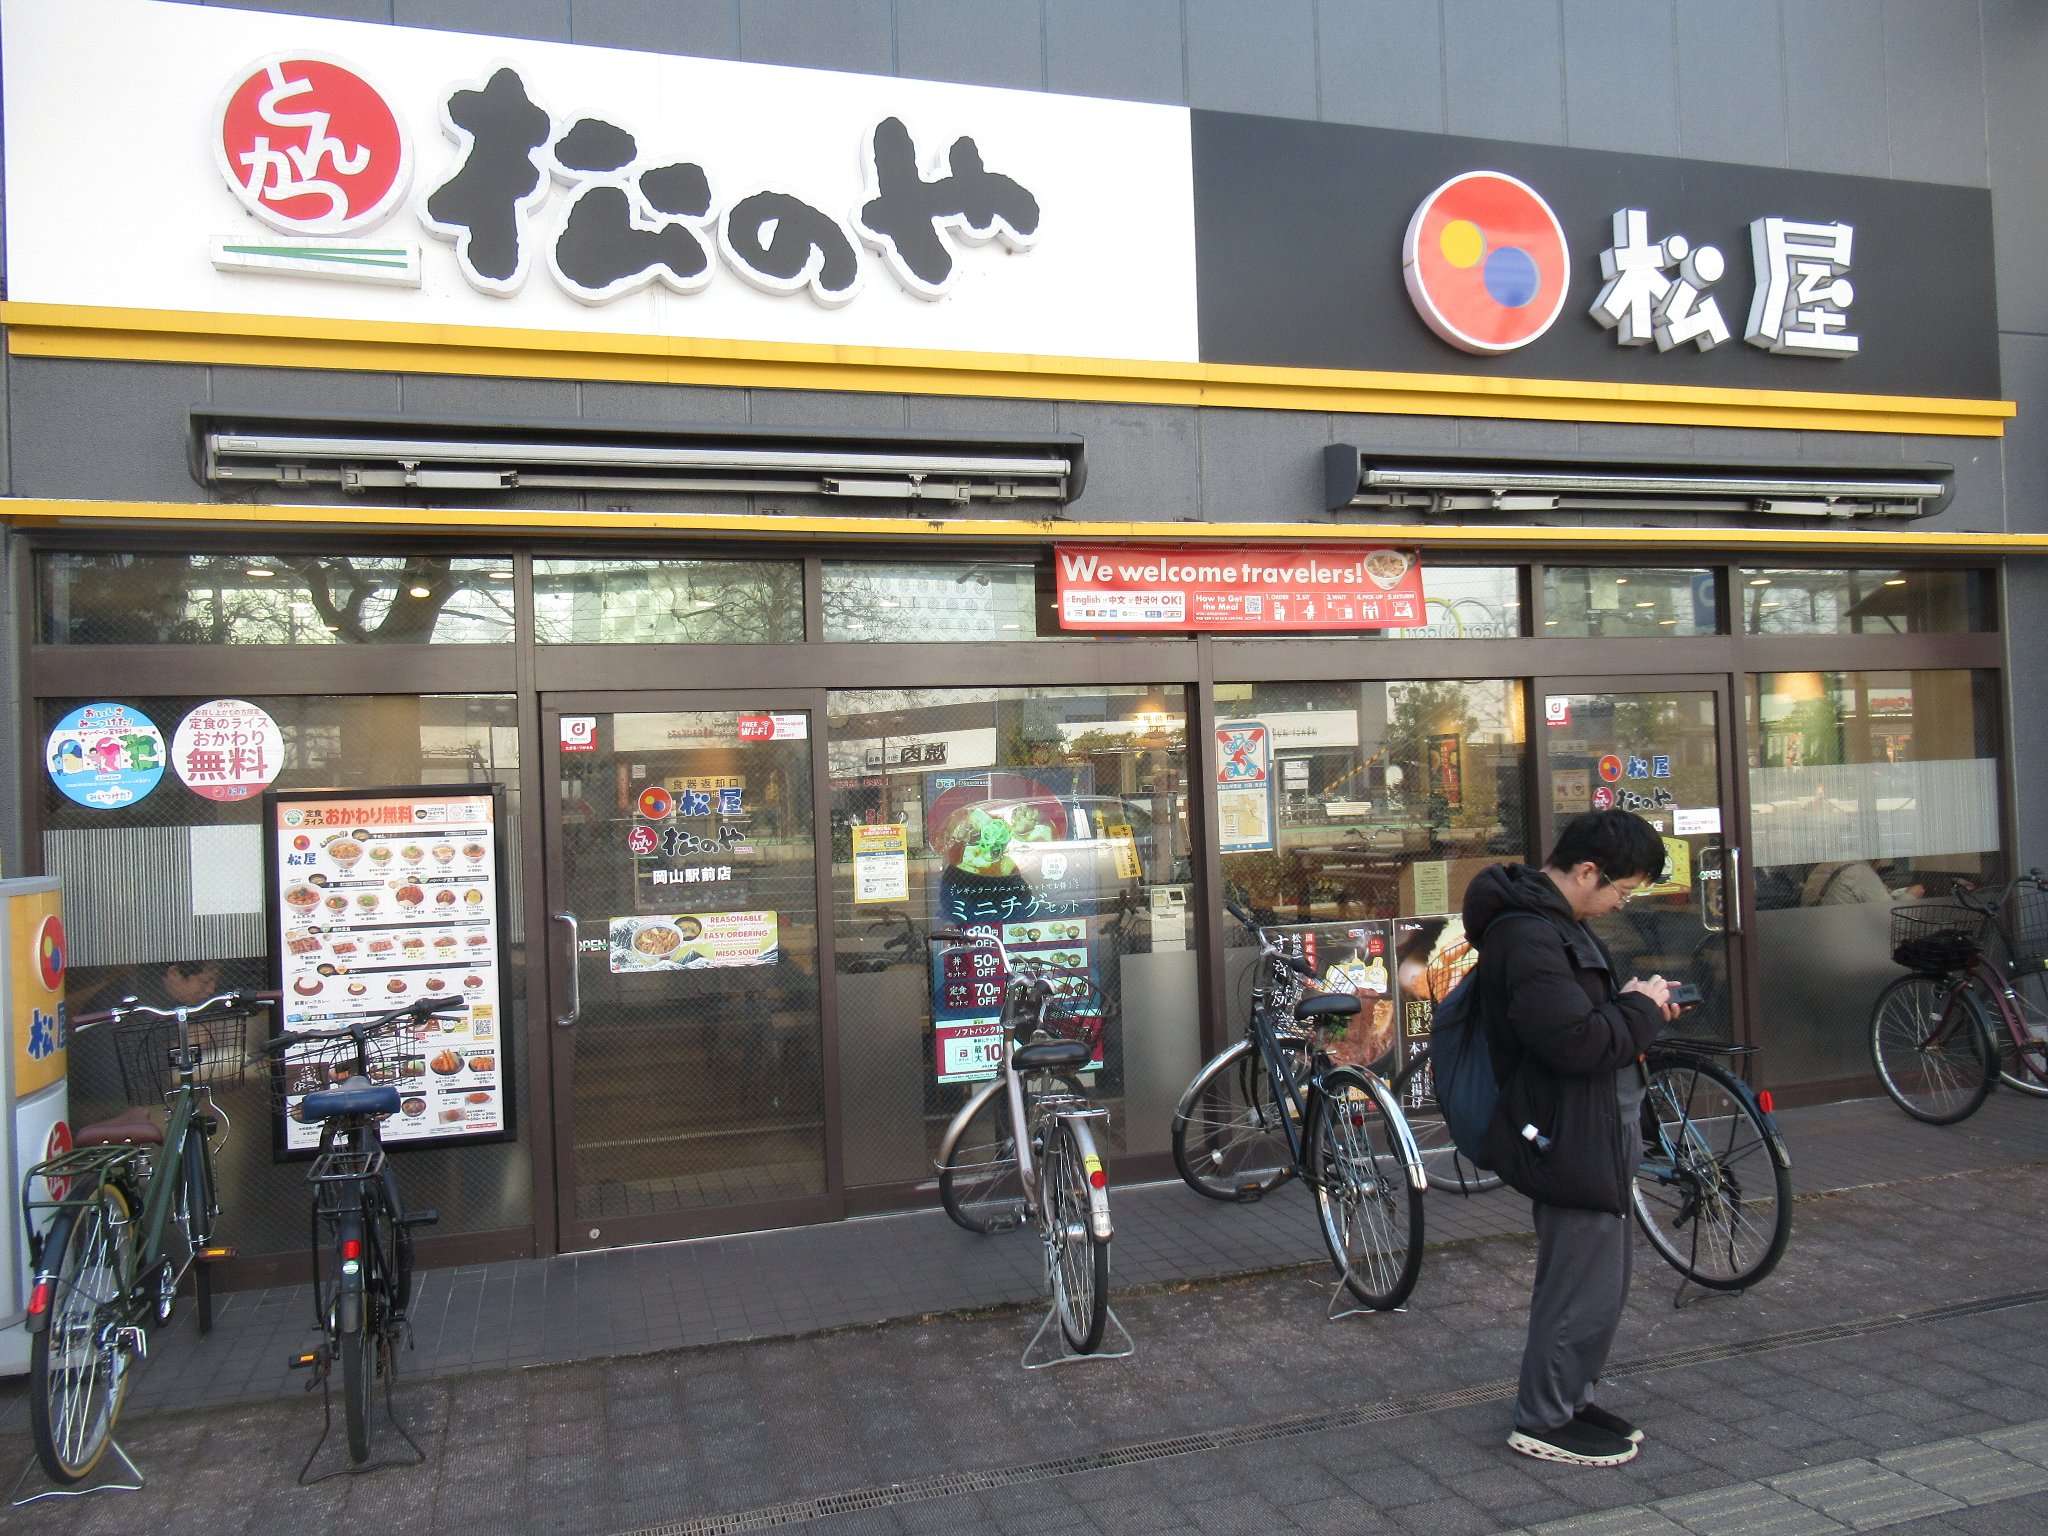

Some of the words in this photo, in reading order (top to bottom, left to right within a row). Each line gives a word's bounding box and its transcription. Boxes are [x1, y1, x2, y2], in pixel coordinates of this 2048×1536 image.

[240, 63, 371, 222] とんかつ
[424, 64, 1042, 296] 松のや
[1590, 208, 1859, 358] 松屋
[1061, 555, 1112, 582] We
[1118, 557, 1237, 583] welcome
[1242, 559, 1362, 584] travelers!
[1071, 595, 1101, 605] English
[1109, 595, 1126, 605] 中文
[1135, 595, 1158, 605] 한국어
[1161, 595, 1182, 605] OK!
[1196, 594, 1215, 602] How
[1218, 603, 1239, 611] Meal
[189, 717, 268, 730] 定食のライス
[193, 730, 264, 746] おかわり
[741, 726, 769, 736] Wi-Fi
[186, 746, 269, 780] 無料
[1627, 755, 1672, 779] 松屋
[673, 779, 739, 790] 食器返却口
[680, 787, 743, 816] 松屋
[1615, 786, 1673, 812] 松のや
[306, 809, 322, 818] 定食
[325, 805, 412, 825] おかわり無料
[303, 818, 325, 826] ライス
[631, 827, 653, 854] とんかつ
[661, 826, 746, 857] 松のや
[287, 852, 317, 866] 松屋
[652, 865, 732, 884] 岡山駅前店
[951, 893, 1079, 921] ミニチゲセット
[710, 914, 762, 924] REASONABLE
[726, 930, 769, 938] ORDERING
[976, 940, 996, 948] OFF
[974, 954, 1000, 968] 50円
[976, 968, 997, 977] OFF
[950, 985, 968, 996] 定食
[975, 983, 1001, 996] 70円
[977, 996, 998, 1006] OFF
[975, 1045, 983, 1063] 最大
